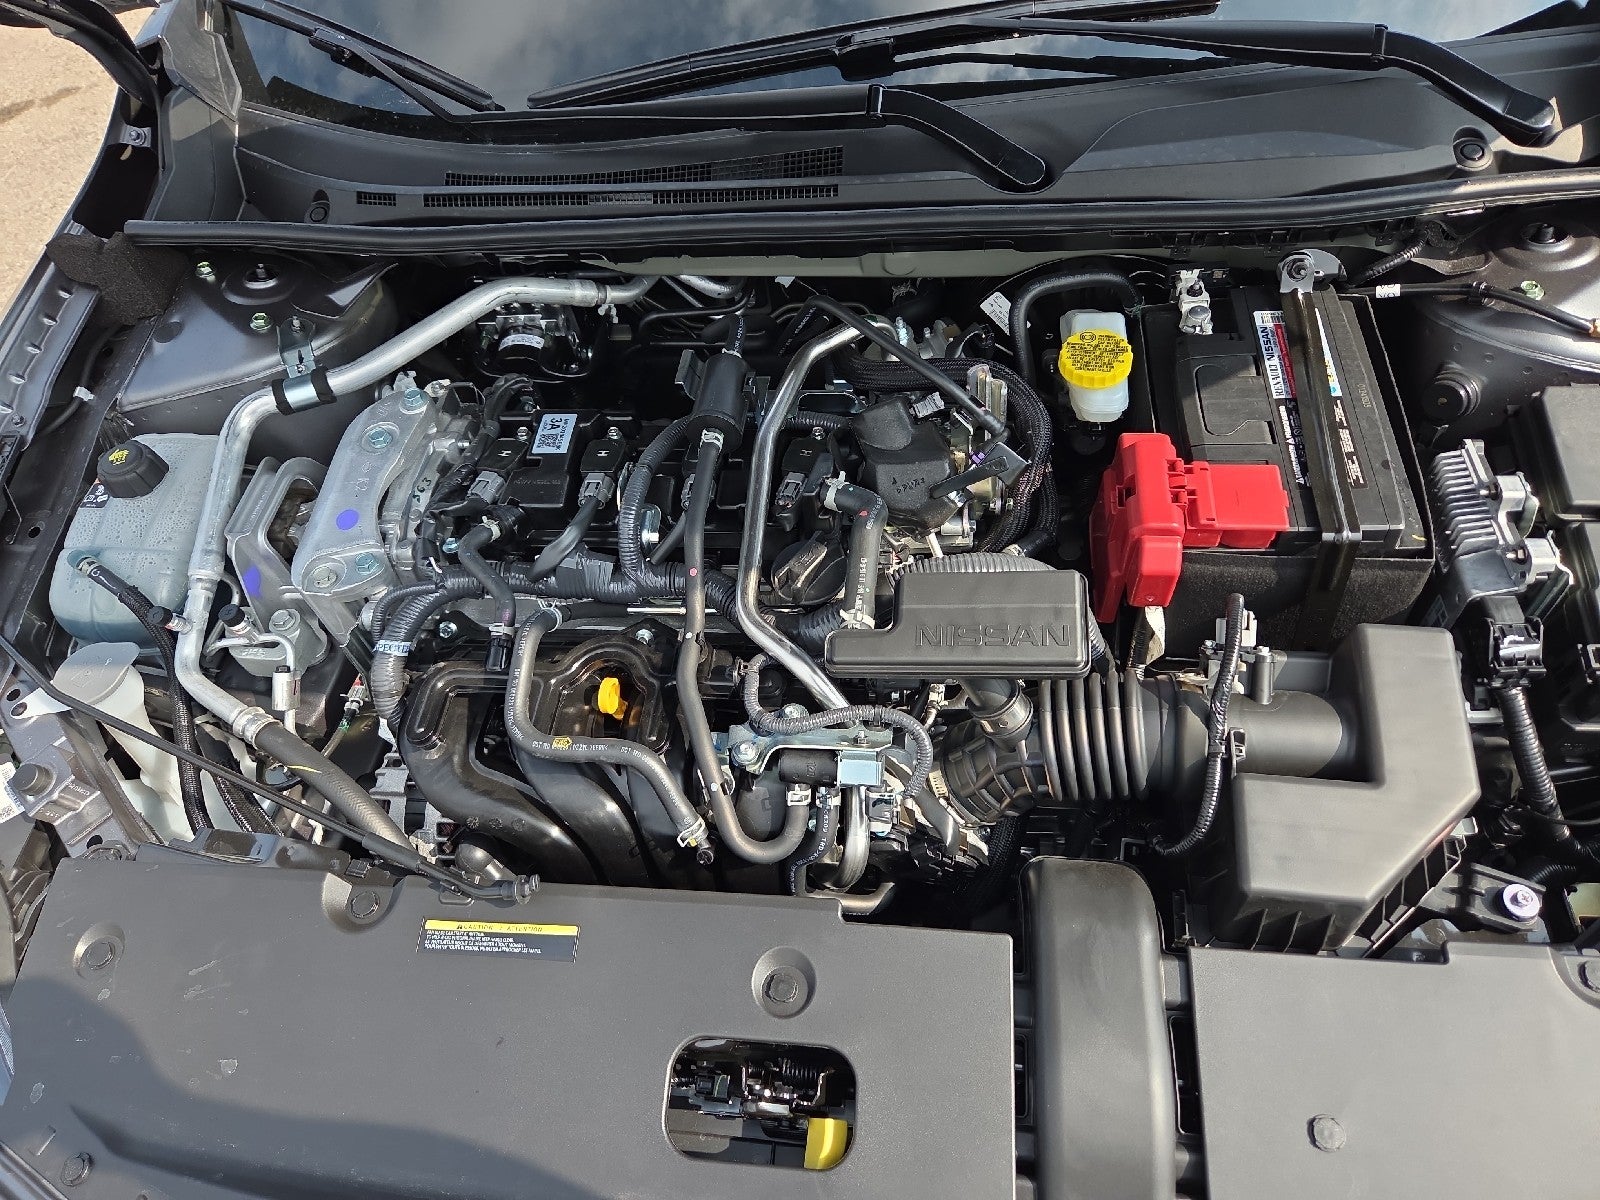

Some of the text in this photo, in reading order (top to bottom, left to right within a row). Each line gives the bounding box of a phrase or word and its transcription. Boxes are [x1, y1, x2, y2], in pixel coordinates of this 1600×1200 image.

[1260, 326, 1284, 396] RENAULT NISSAN
[547, 417, 562, 430] 3A
[915, 624, 1071, 647] NISSAN
